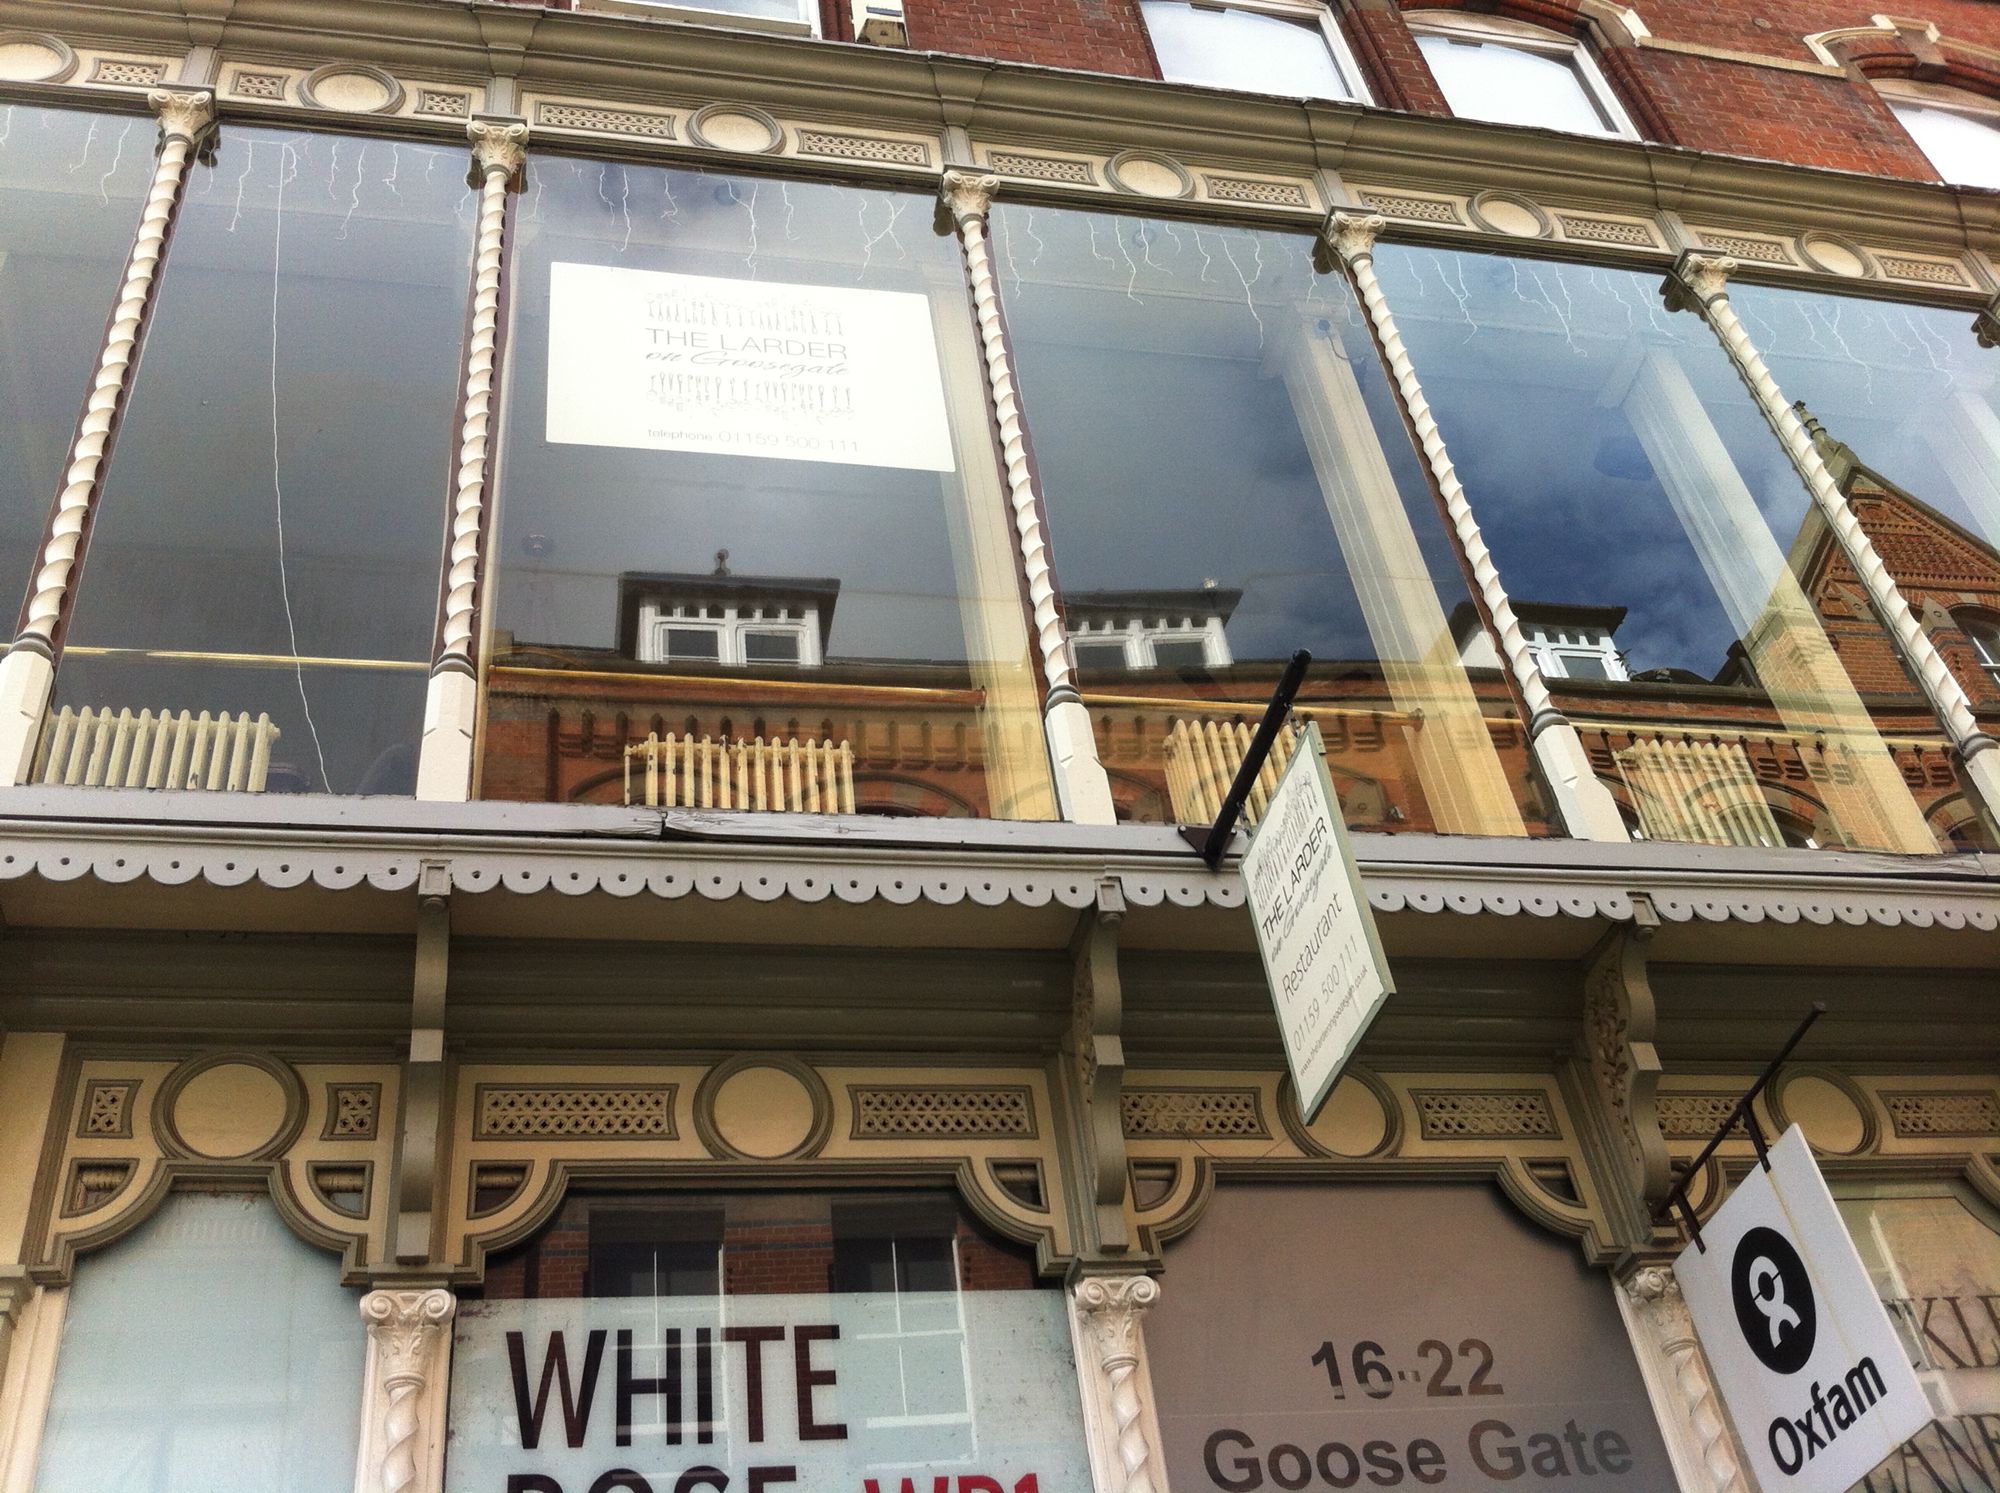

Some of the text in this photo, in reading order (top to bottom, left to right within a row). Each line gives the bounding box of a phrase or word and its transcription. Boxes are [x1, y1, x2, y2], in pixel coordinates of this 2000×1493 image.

[645, 327, 848, 360] THE LARDER
[645, 350, 850, 379] on Goosegate
[648, 428, 859, 454] telephone 01159 500 111
[1262, 816, 1328, 941] THE LARDER
[1281, 892, 1343, 1004] Restaurant
[1293, 933, 1359, 1052] 01159 500 111
[506, 1324, 848, 1450] WHITE
[1311, 1338, 1504, 1400] 16-22
[1203, 1418, 1634, 1493] Goose Gate
[1768, 1356, 1888, 1476] Oxfam
